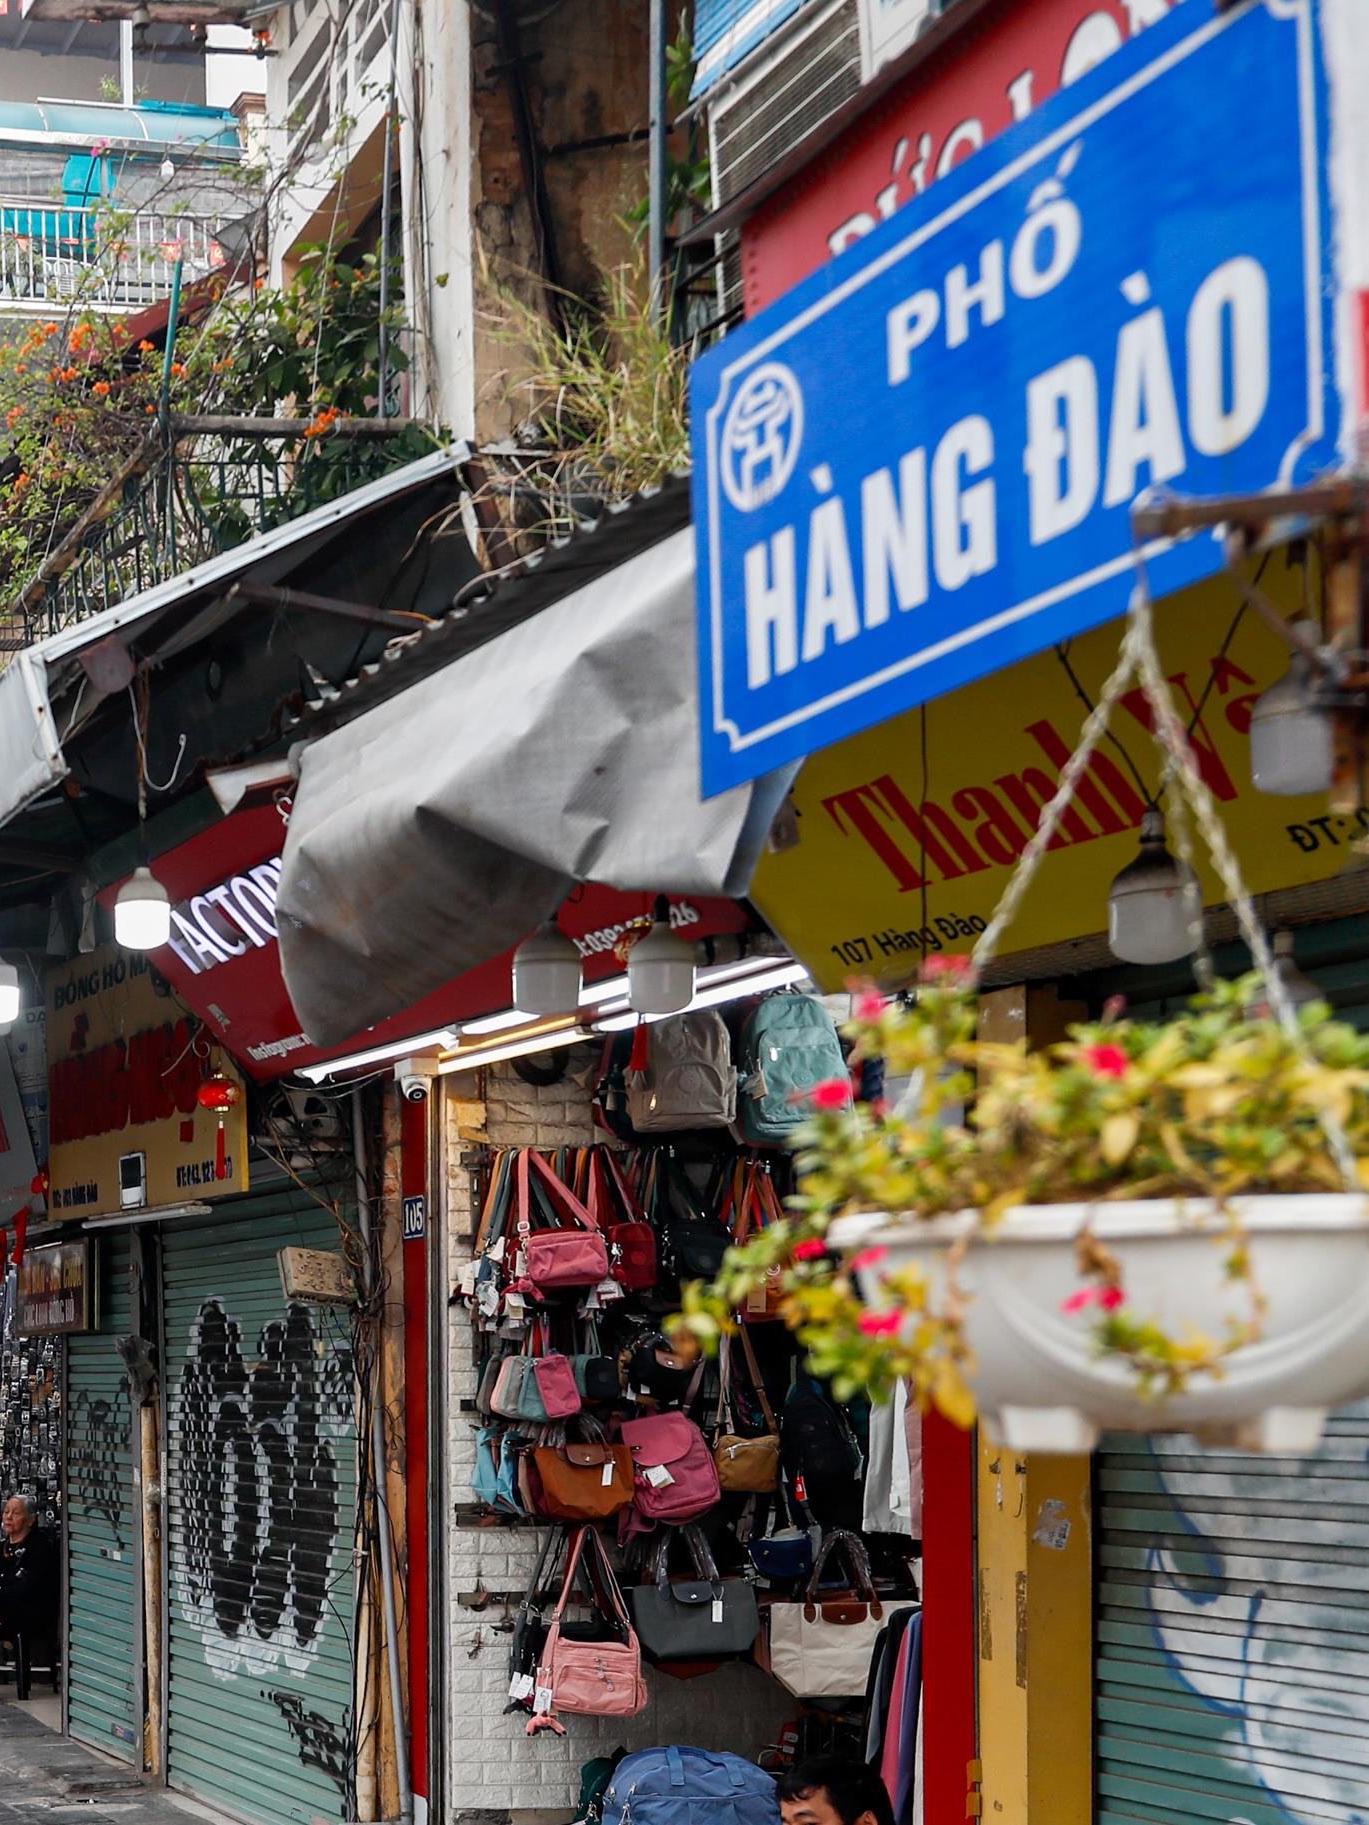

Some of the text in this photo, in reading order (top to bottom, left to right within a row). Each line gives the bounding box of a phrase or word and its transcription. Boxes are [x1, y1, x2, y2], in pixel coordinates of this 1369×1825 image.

[887, 139, 1083, 387] PHỐ
[744, 255, 1269, 690] HÀNG ĐÀO
[821, 718, 1153, 893] Thanh
[831, 912, 987, 967] 107 Hàng Đào
[405, 1202, 423, 1233] 105
